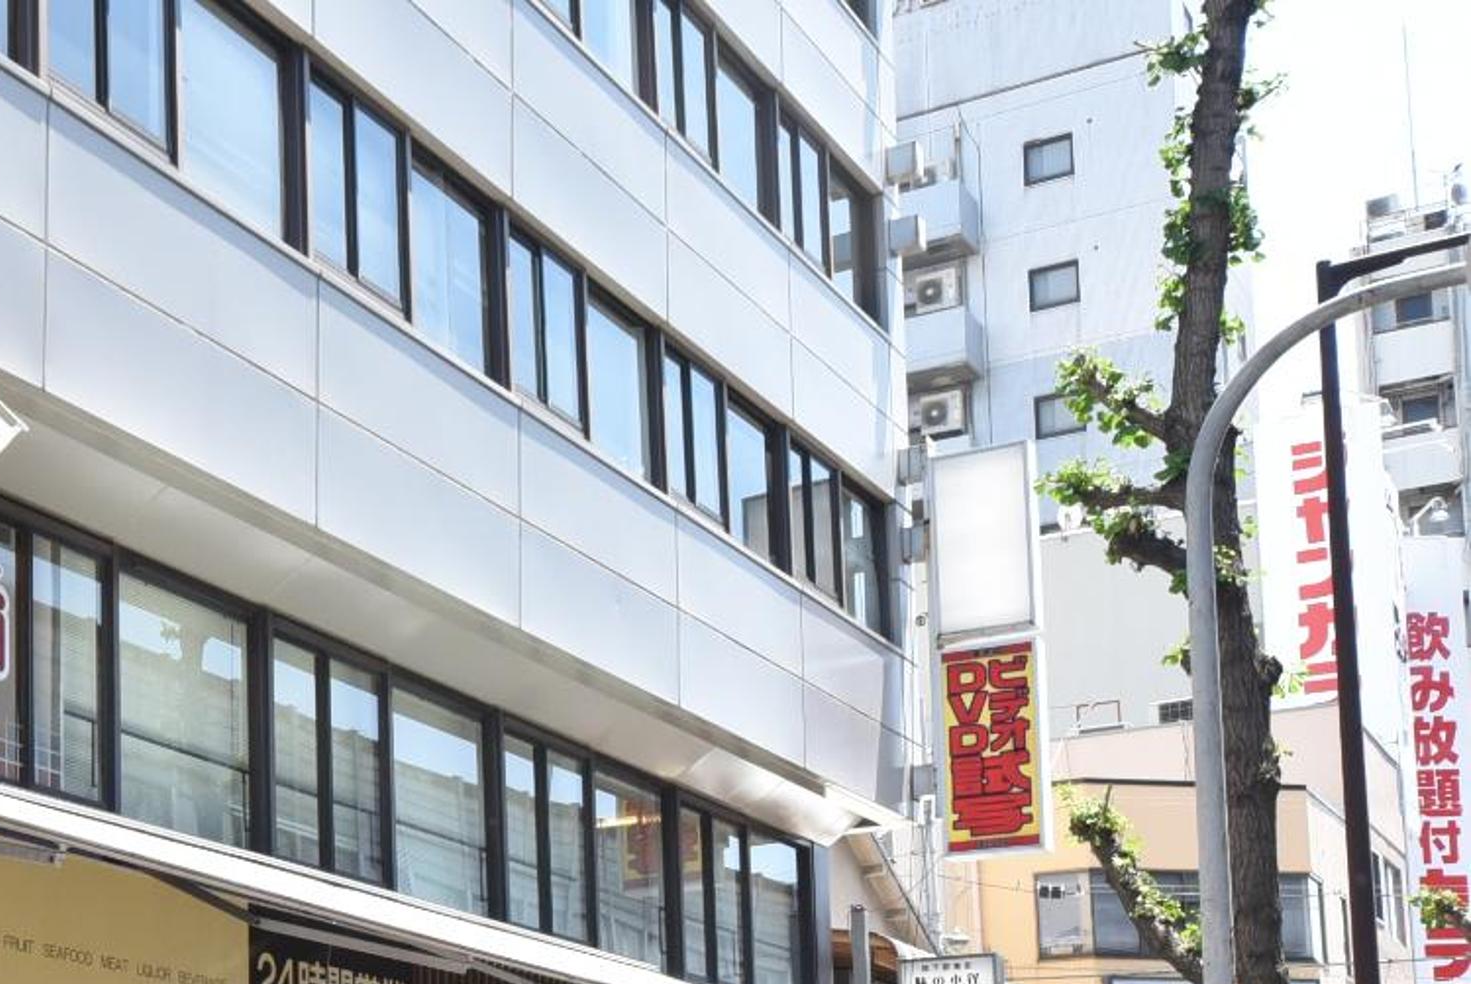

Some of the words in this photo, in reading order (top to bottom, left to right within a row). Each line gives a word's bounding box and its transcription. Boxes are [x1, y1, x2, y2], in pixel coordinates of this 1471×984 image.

[947, 661, 989, 758] DVD
[2, 933, 36, 955] FRUIT
[42, 942, 94, 968] SEAFOOD
[100, 954, 129, 975] MEAT
[136, 960, 173, 983] LIQUOR
